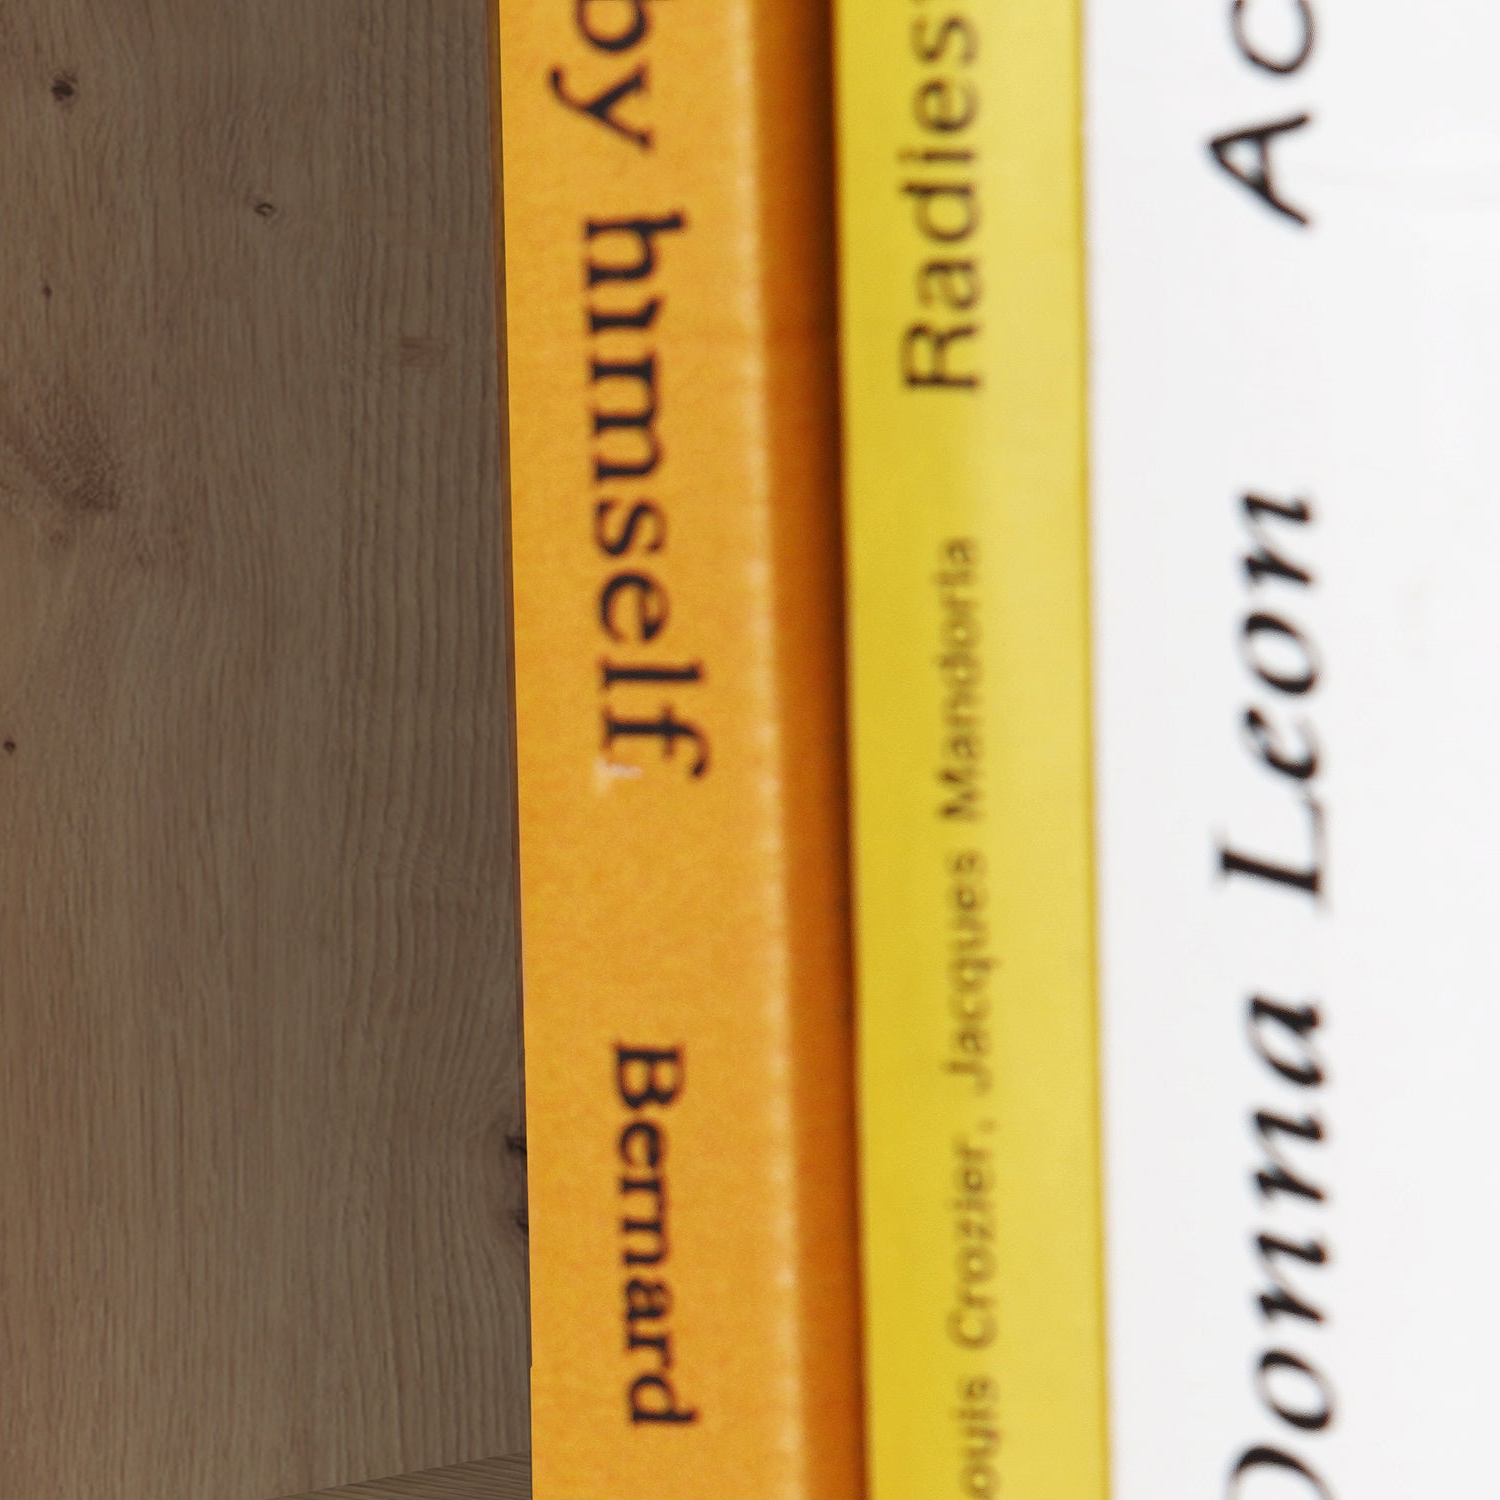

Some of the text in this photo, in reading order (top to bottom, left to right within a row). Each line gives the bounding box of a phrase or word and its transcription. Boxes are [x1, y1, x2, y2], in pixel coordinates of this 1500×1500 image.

[581, 211, 711, 779] himself
[1215, 490, 1326, 905] Leon
[940, 847, 1003, 1097] Jacques
[612, 1042, 699, 1428] Bernard
